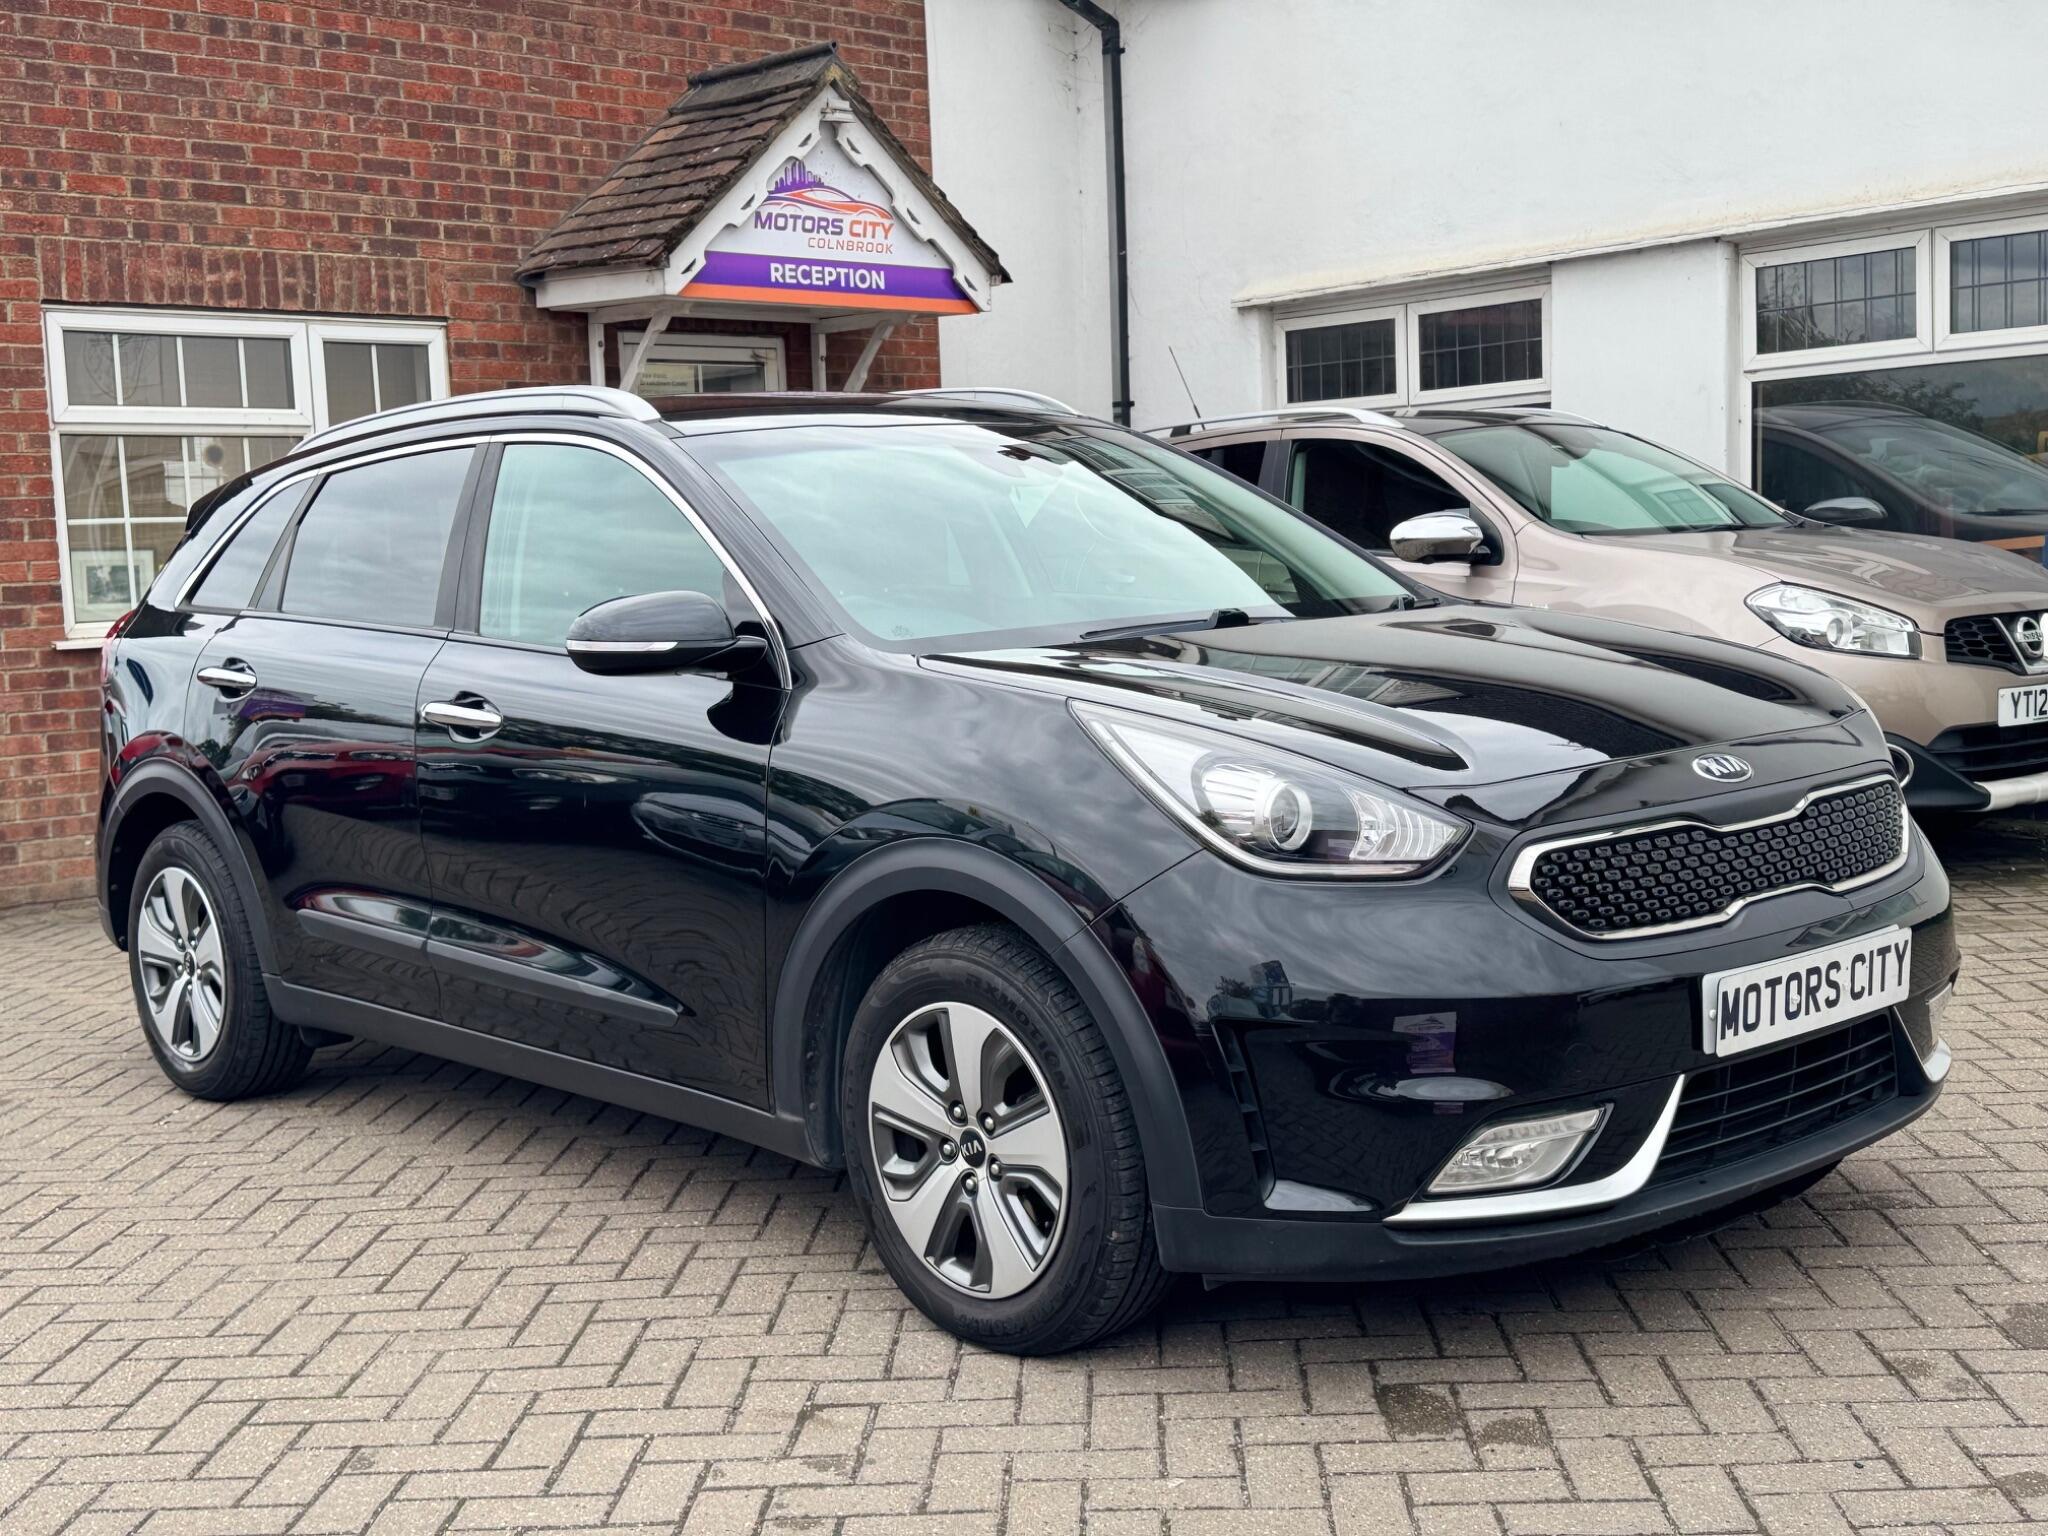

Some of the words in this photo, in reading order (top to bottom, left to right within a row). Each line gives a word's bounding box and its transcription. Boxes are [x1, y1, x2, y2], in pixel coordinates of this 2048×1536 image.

[754, 211, 844, 236] MOTORS
[849, 219, 895, 240] CITY
[808, 237, 893, 254] COLNBROOK
[770, 262, 885, 290] RECEPTION
[1720, 960, 1841, 1040] MOTORS
[1850, 939, 1909, 1001] CITY
[960, 1139, 982, 1157] KIA
